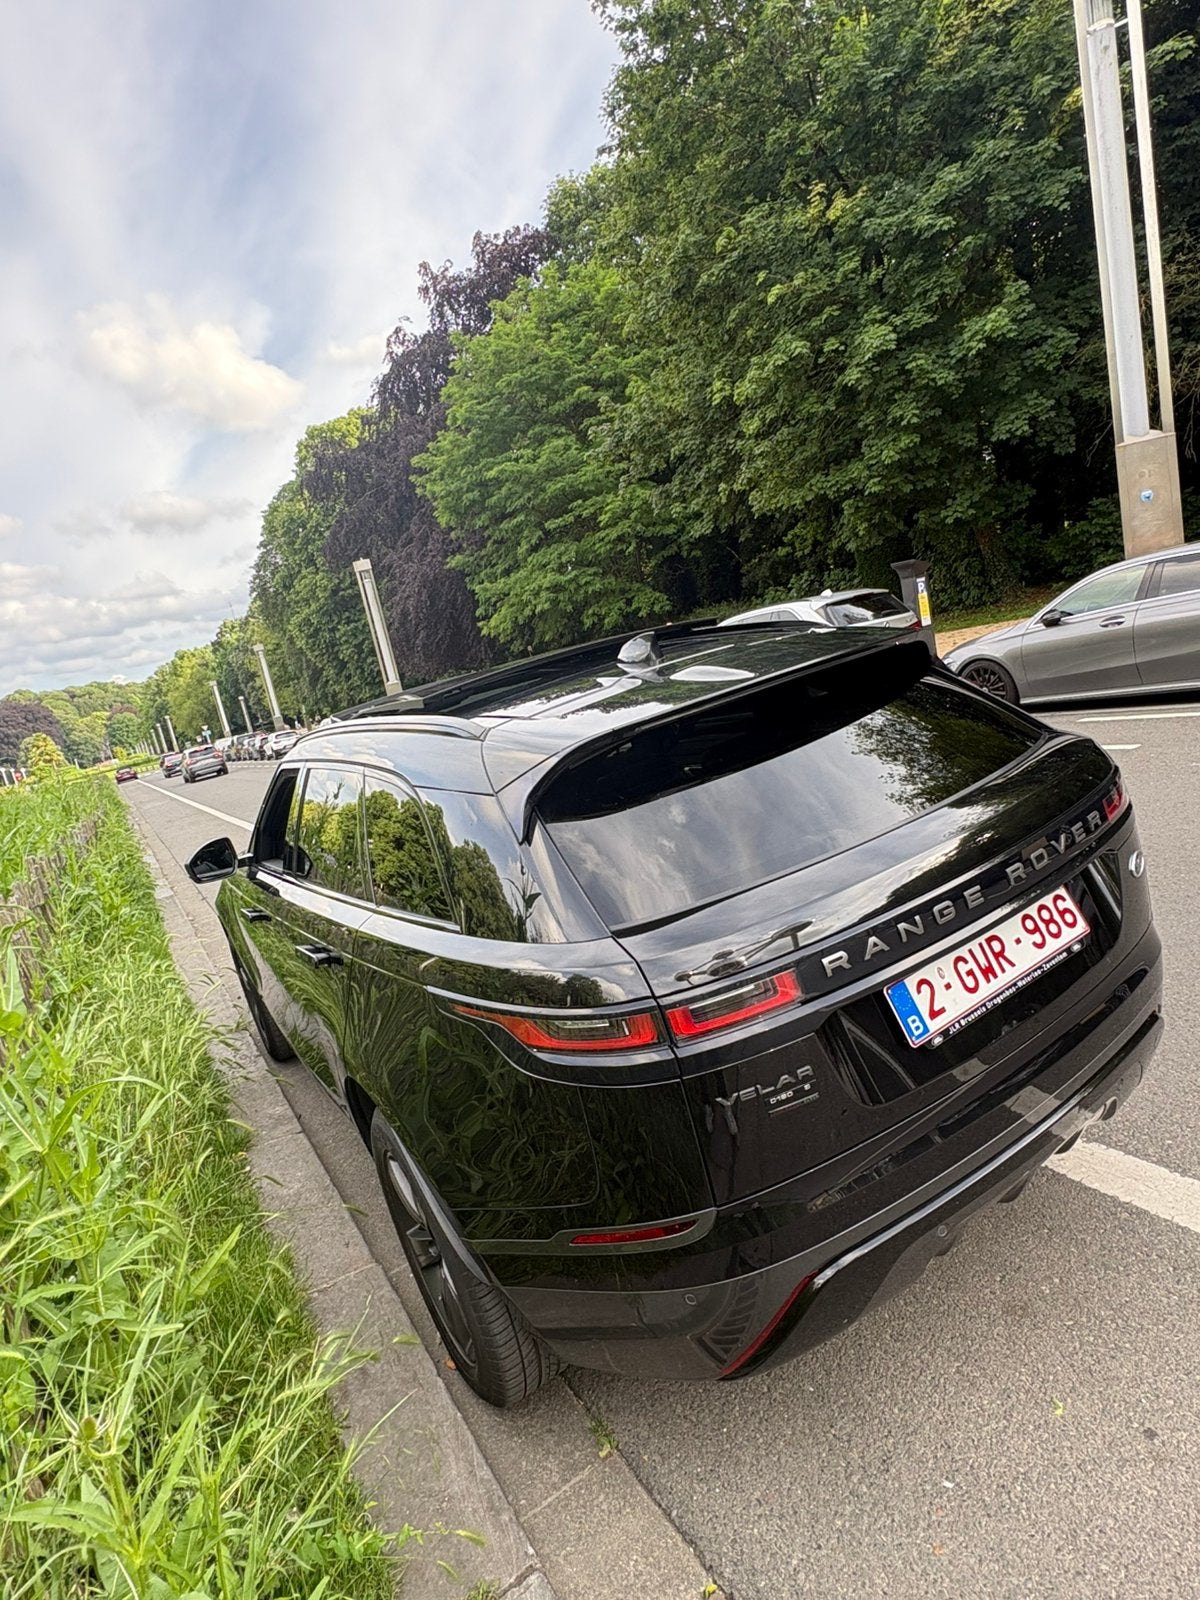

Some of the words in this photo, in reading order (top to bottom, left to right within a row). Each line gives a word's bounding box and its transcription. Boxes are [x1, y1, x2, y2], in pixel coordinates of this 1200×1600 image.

[821, 885, 985, 978] RANGE
[1006, 809, 1103, 886] ROVER
[915, 893, 1078, 1021] 2-GWR-986
[906, 1015, 924, 1037] B
[949, 1021, 961, 1035] JLR
[960, 1005, 987, 1028] Brussels
[715, 1065, 815, 1106] VELAR
